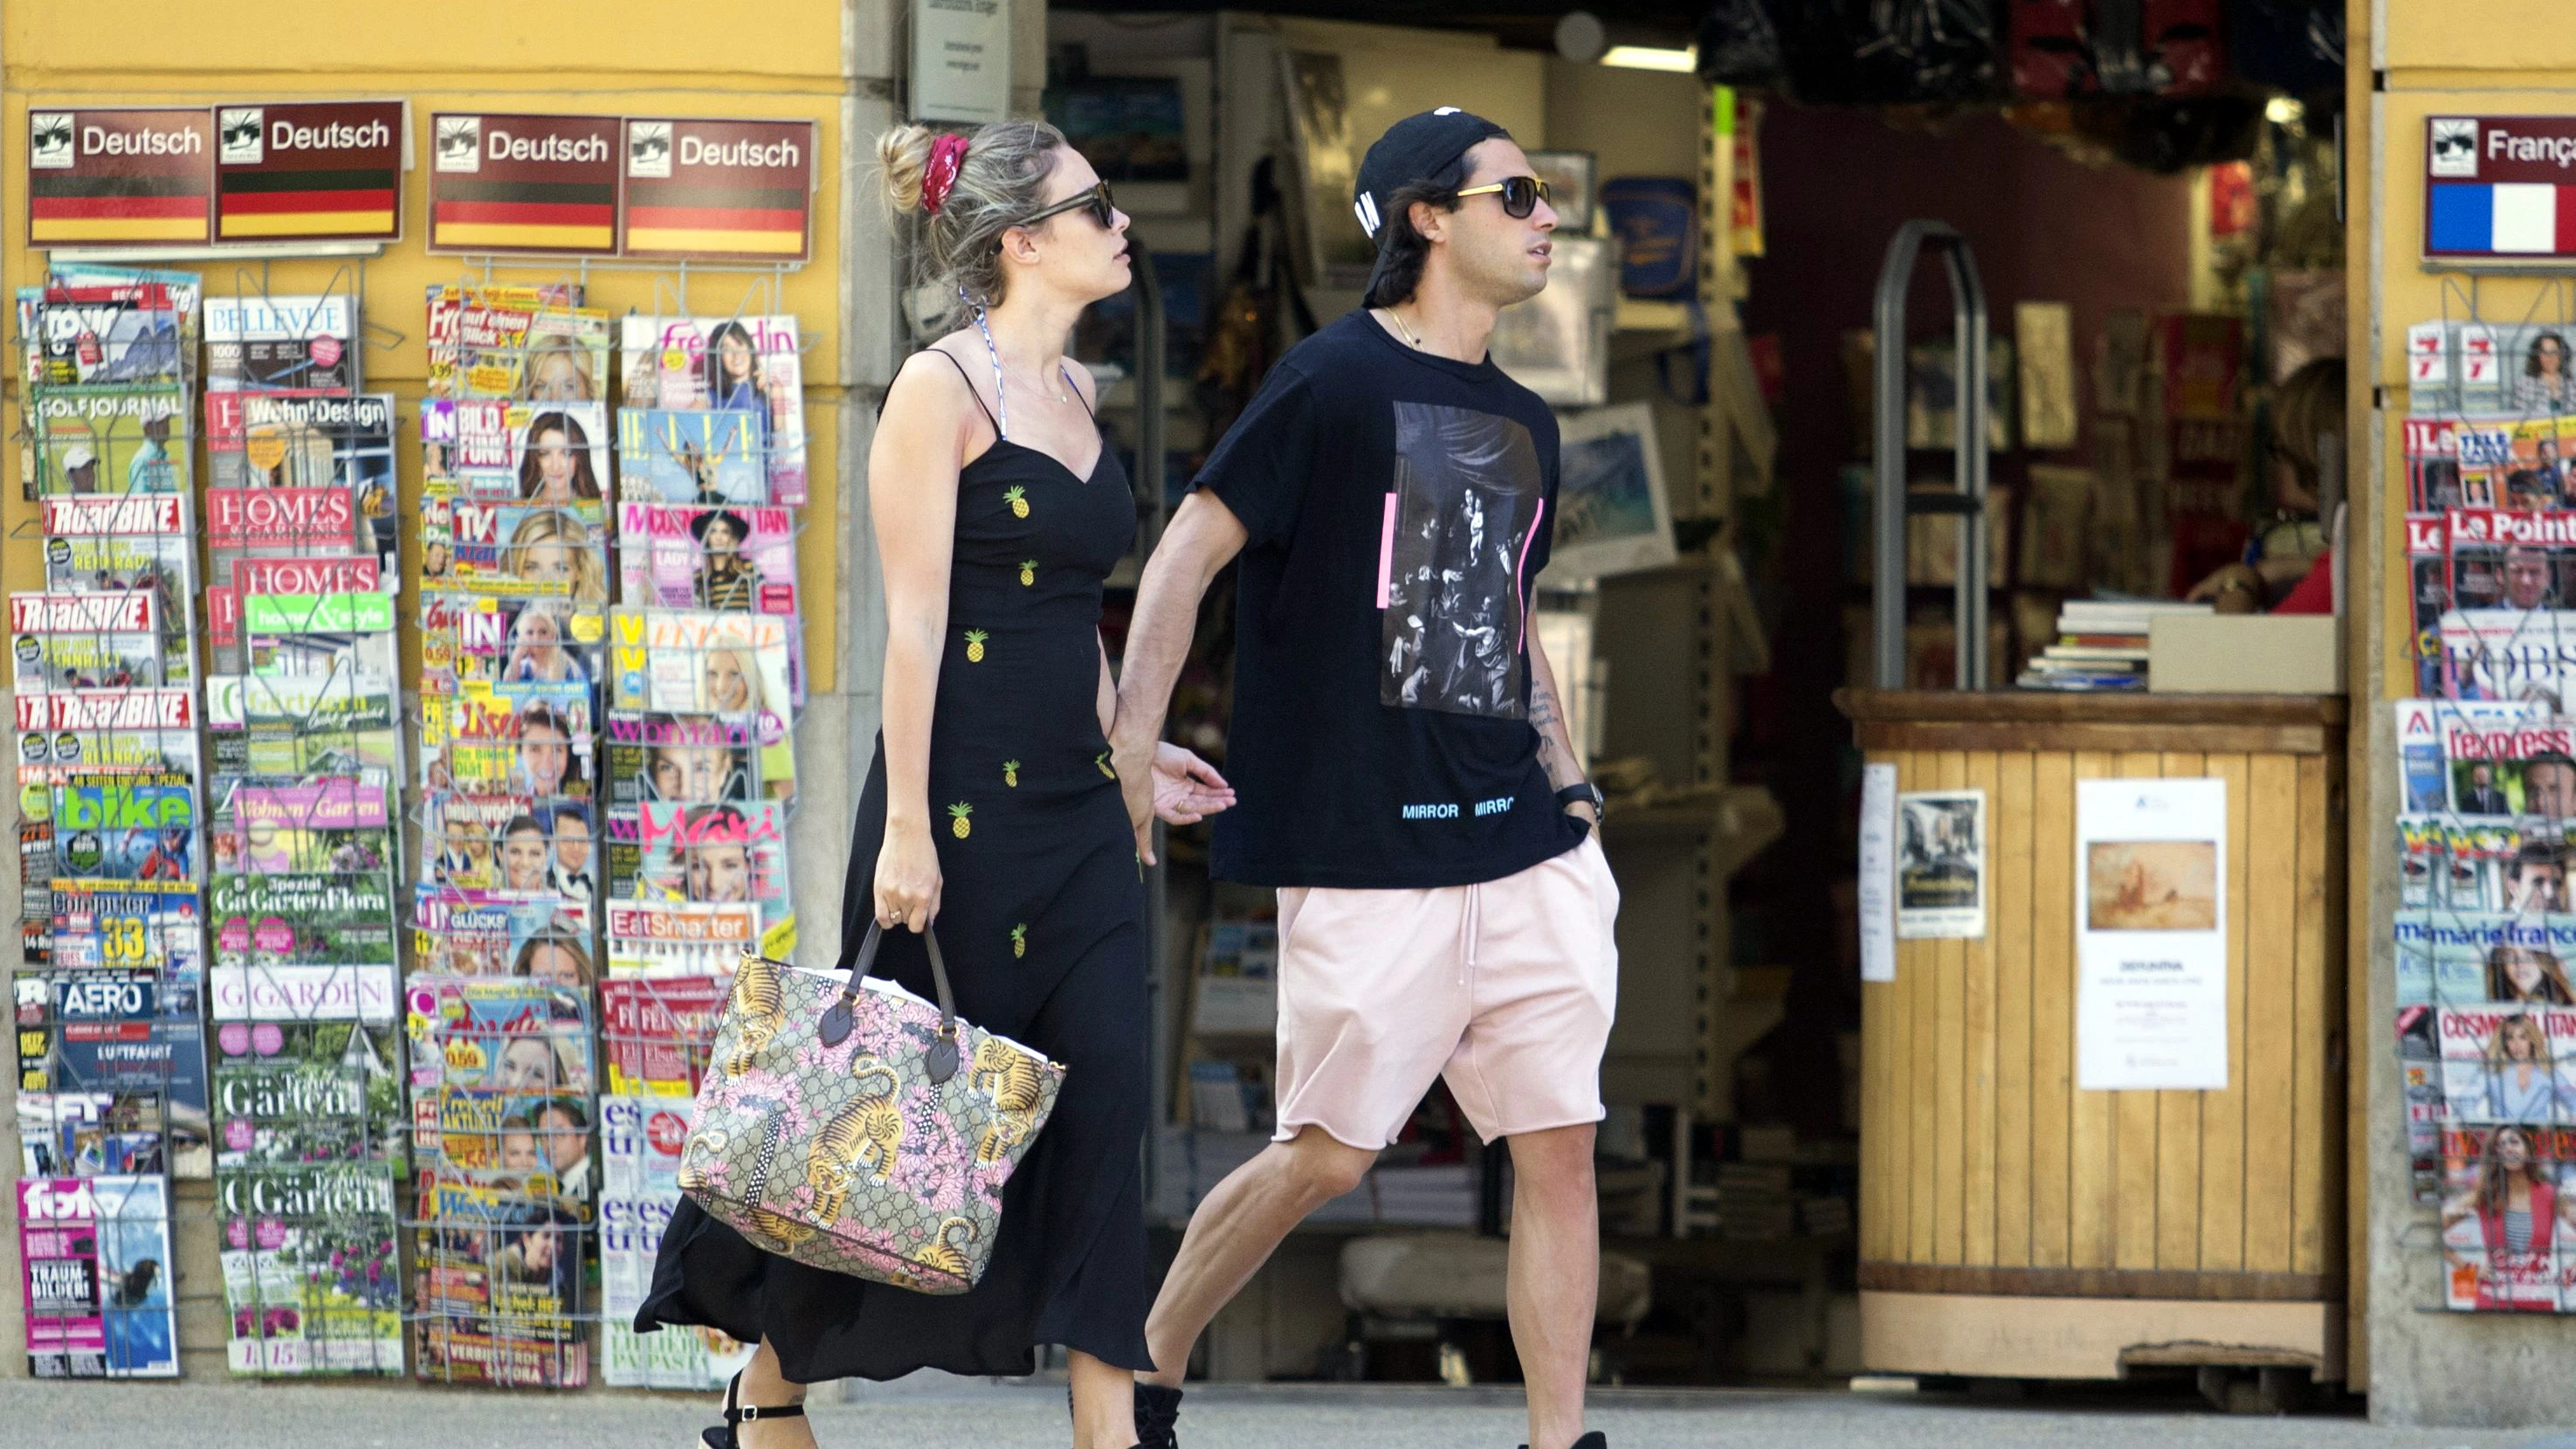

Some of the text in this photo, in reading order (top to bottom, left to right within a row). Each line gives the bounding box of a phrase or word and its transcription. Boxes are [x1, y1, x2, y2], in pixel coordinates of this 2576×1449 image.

[83, 126, 201, 155] Deutsch
[272, 119, 389, 150] Deutsch
[488, 131, 608, 162] Deutsch
[680, 135, 799, 167] Deutsch
[212, 307, 341, 332] BELLEVUE
[51, 499, 175, 535] RoadBIKE
[221, 494, 348, 526] HOMES
[457, 507, 496, 542] TV
[2449, 510, 2489, 539] Le
[247, 563, 375, 595] HOMES
[460, 701, 522, 739] Lisa
[610, 720, 748, 746] woman
[65, 786, 190, 830] bike
[1402, 804, 1459, 819] MIRROR
[639, 800, 782, 854] Maxi
[102, 917, 146, 959] 33
[63, 983, 143, 1015] AERO
[24, 1180, 125, 1220] foto
